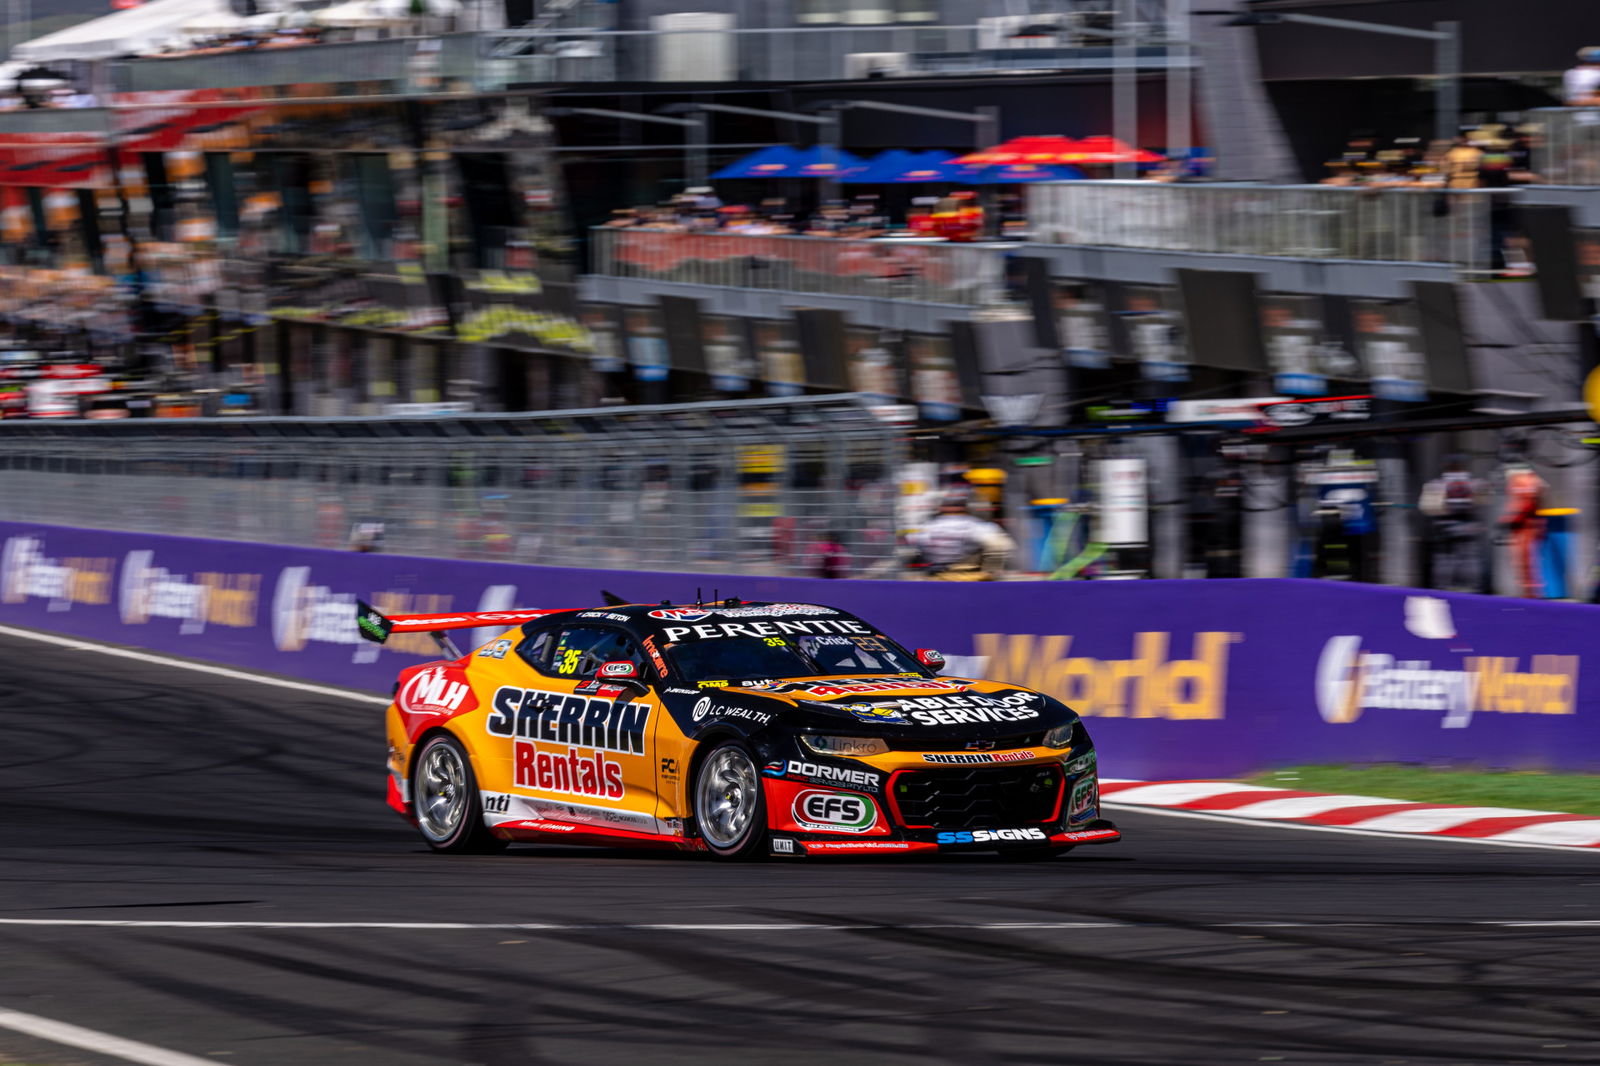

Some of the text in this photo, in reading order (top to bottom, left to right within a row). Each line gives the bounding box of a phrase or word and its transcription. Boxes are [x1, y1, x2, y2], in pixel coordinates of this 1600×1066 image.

[662, 620, 872, 642] PERENTIE
[815, 635, 854, 646] Crick
[763, 637, 786, 647] 35
[559, 649, 582, 674] 35
[607, 664, 628, 672] EFS
[972, 631, 1234, 720] World
[411, 672, 470, 711] MLH
[900, 691, 1040, 712] ABLE DOOR
[486, 685, 652, 756] SHERRIN
[709, 705, 725, 716] LC
[910, 705, 1041, 726] SERVICES
[831, 737, 877, 752] Linkro
[923, 750, 1035, 764] SHERRIN Rentals
[514, 738, 625, 800] Rentals
[788, 760, 880, 787] DORMER
[485, 794, 511, 812] nti
[807, 797, 861, 821] EFS
[774, 840, 793, 853] UNIT
